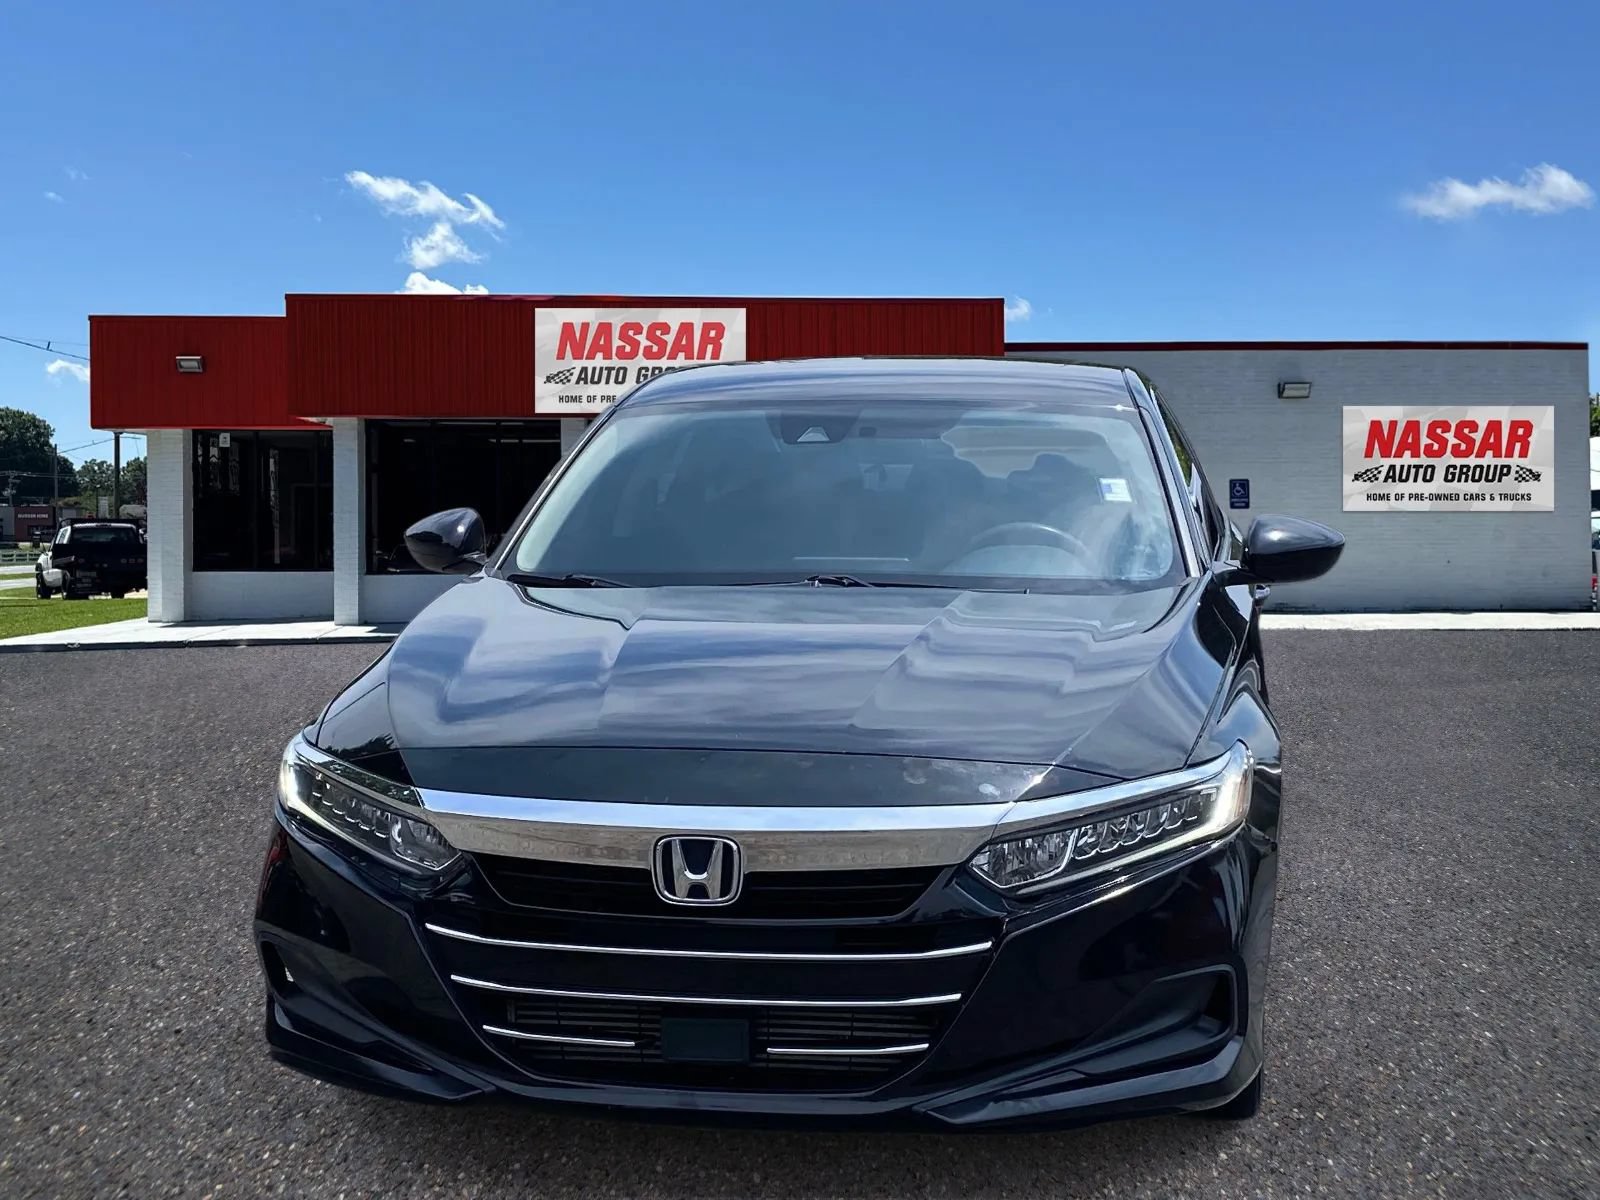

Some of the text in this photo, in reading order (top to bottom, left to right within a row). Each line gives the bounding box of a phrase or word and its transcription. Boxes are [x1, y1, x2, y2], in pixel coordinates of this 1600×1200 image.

[556, 322, 726, 360] NASSAR
[575, 366, 627, 385] AUTO
[558, 395, 583, 403] HOME
[586, 395, 597, 403] OF
[1364, 420, 1534, 458] NASSAR
[1383, 464, 1512, 483] AUTO GROUP
[1366, 493, 1532, 501] HOME OF PRE-OWNED CARS & TRUCKS
